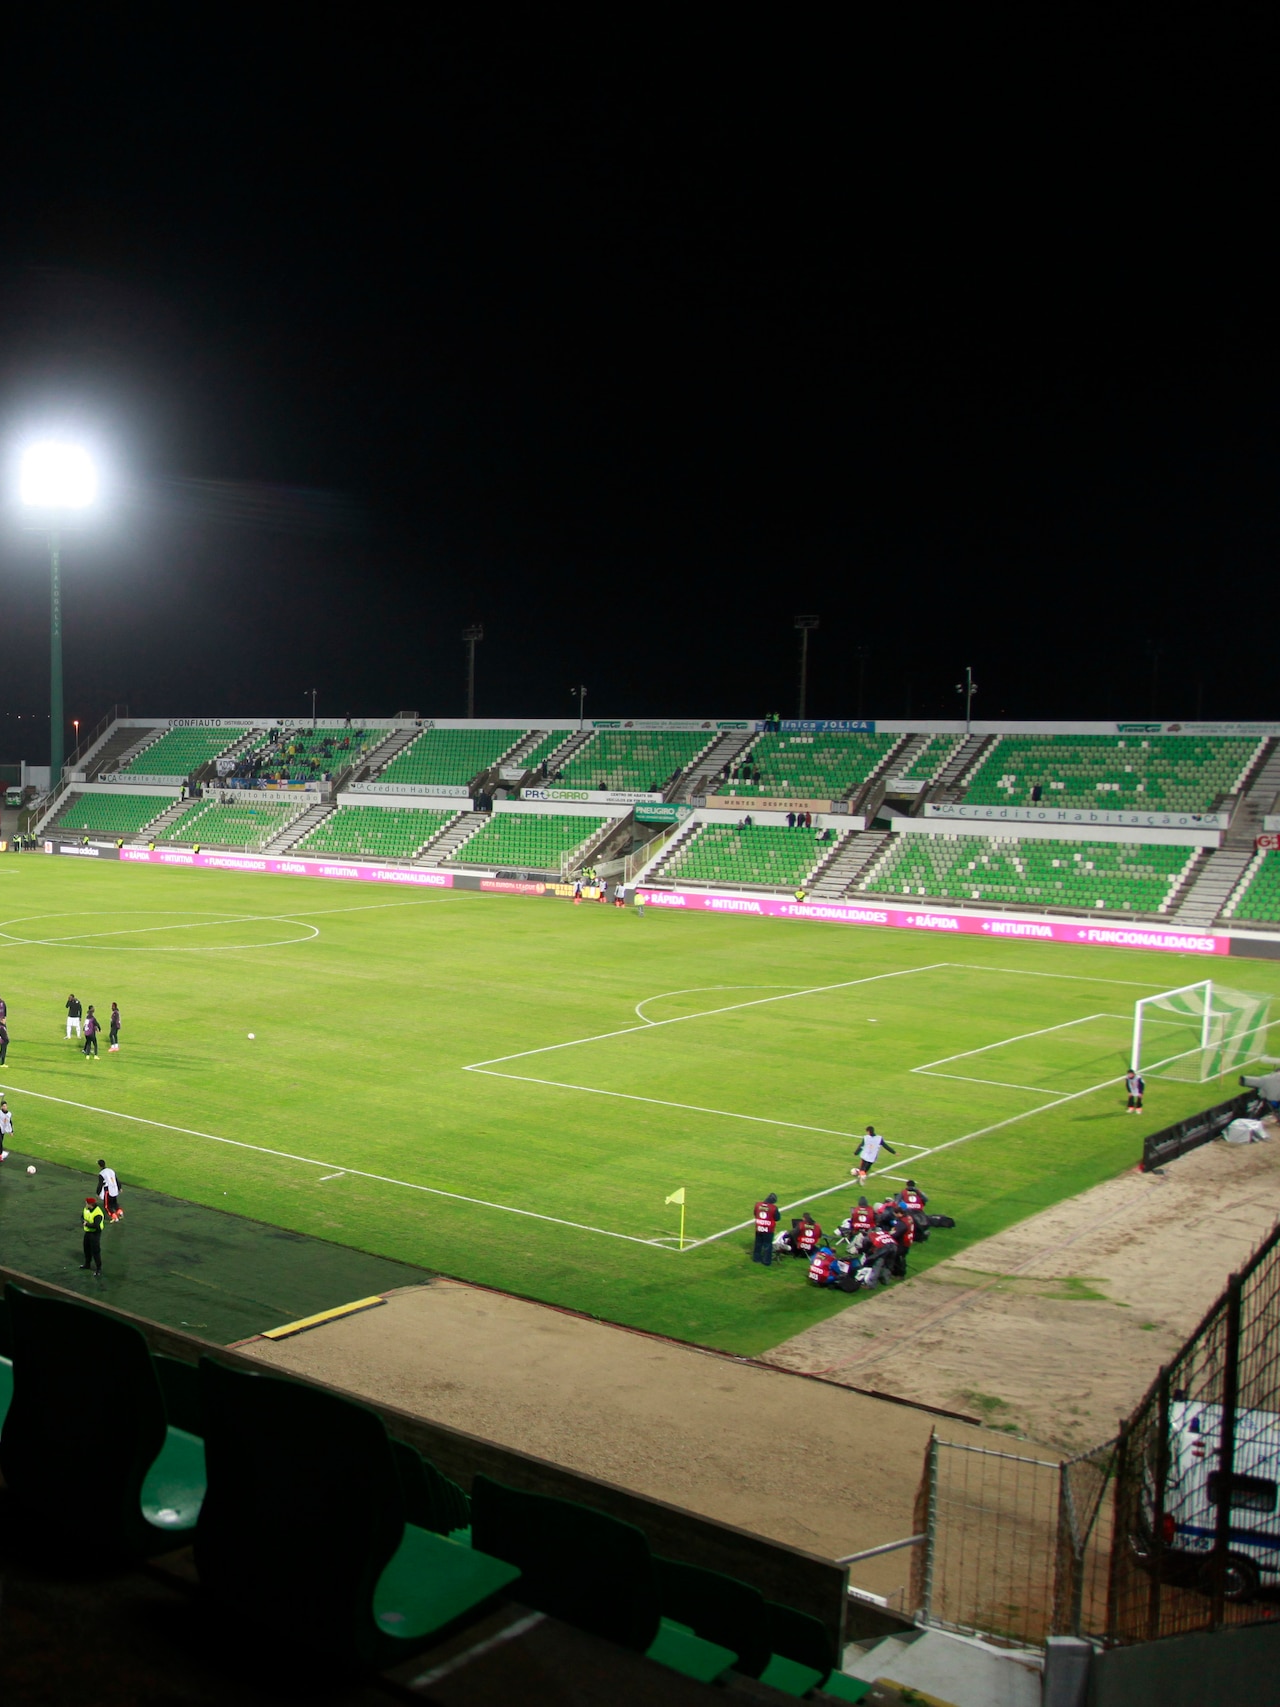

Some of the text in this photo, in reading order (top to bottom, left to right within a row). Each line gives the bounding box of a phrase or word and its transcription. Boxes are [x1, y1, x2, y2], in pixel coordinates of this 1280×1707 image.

[173, 719, 221, 727] CONFIAUTO
[822, 721, 868, 729] JOLICA
[635, 806, 675, 815] PNEUGIRO
[942, 804, 1219, 825] CA Crédito Habitação CA
[129, 851, 150, 861] RÁPIDA
[165, 853, 193, 864] INTUITIVA
[209, 857, 266, 870] FUNCIONALIDADES
[282, 862, 306, 873] RÁPIDA
[324, 866, 358, 878] INTUITIVA
[377, 872, 446, 885] FUNCIONALIDADES
[650, 892, 686, 906] RÁPIDA
[712, 898, 761, 912] INTUITIVA
[788, 904, 888, 923] FUNCIONALIDADES
[915, 914, 959, 930] RÁPIDA
[991, 920, 1053, 938] INTUITIVA
[1087, 929, 1216, 951] FUNCIONALIDADES
